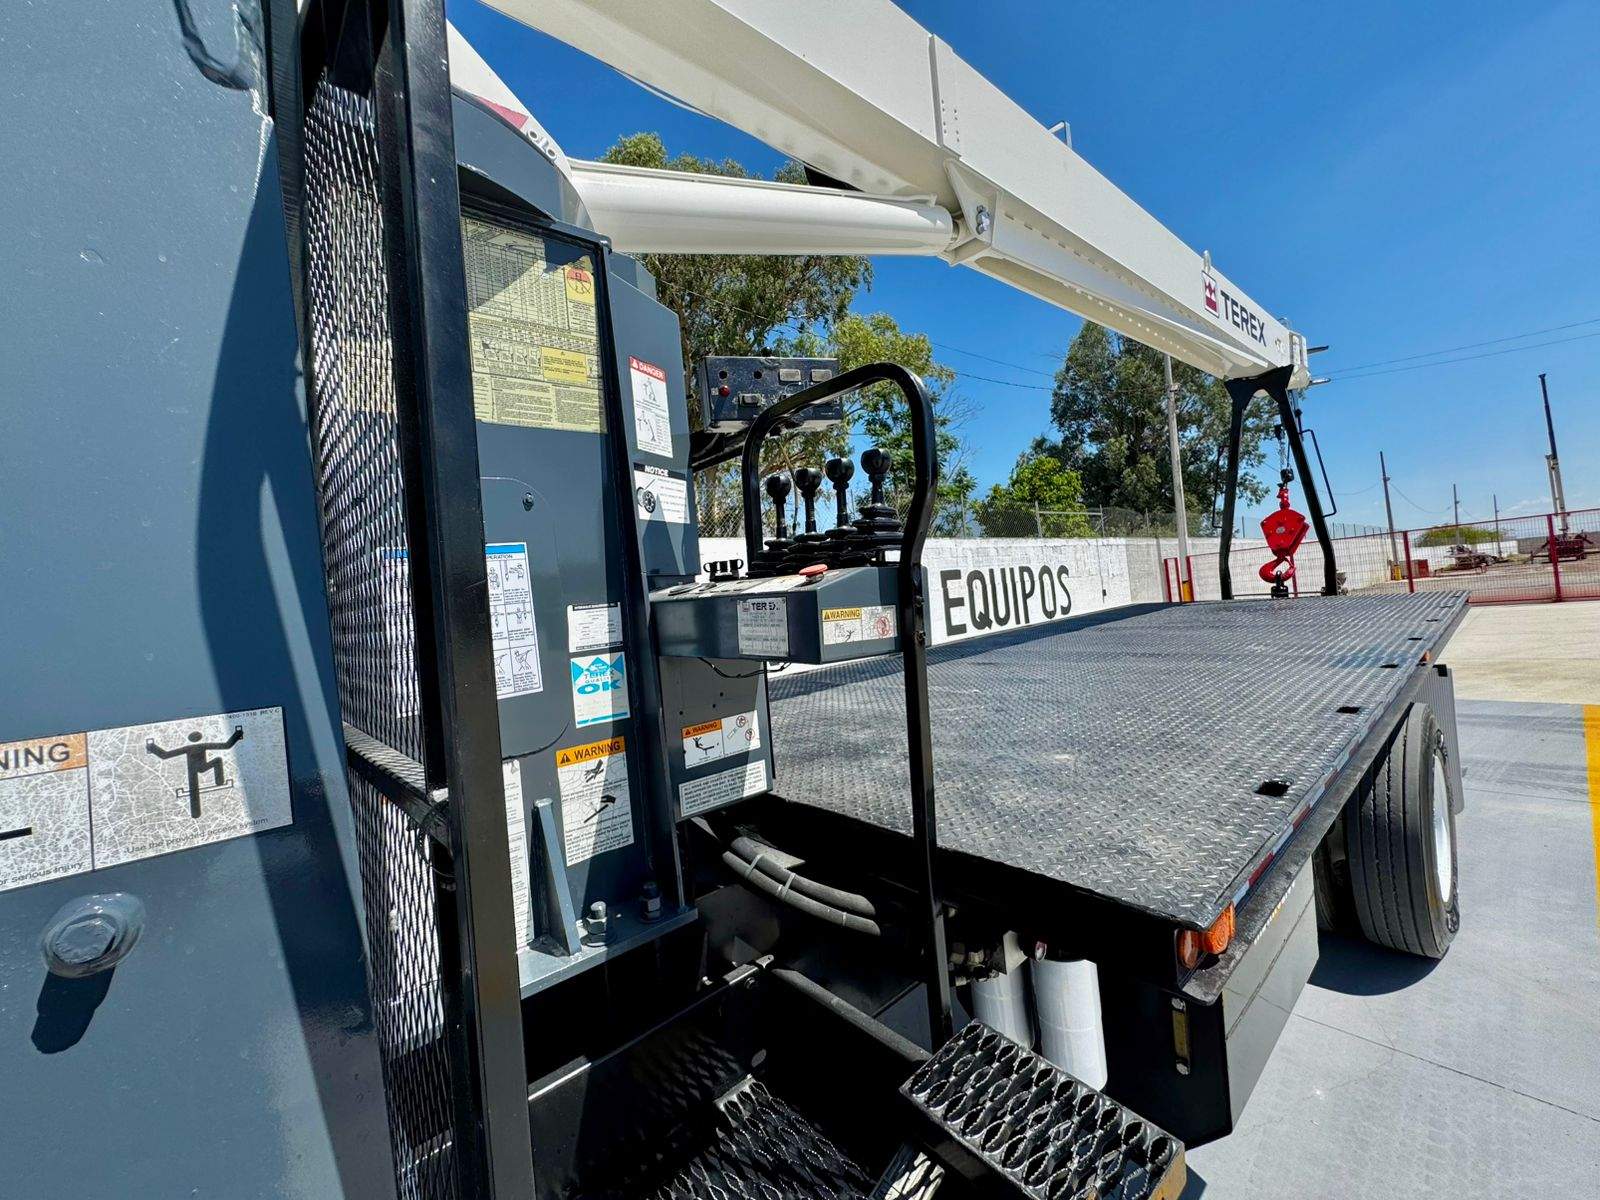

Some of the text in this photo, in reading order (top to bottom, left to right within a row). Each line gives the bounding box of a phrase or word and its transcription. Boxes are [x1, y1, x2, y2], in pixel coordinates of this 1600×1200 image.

[1220, 290, 1267, 348] TEREX
[639, 362, 665, 379] DANGER
[644, 465, 669, 477] NOTICE
[940, 564, 1072, 637] EQUIPOS
[830, 609, 860, 619] WARNING
[577, 679, 622, 695] OK
[692, 721, 718, 733] WARNING
[574, 741, 621, 760] WARNING
[11, 869, 52, 883] serious
[53, 862, 84, 874] injury
